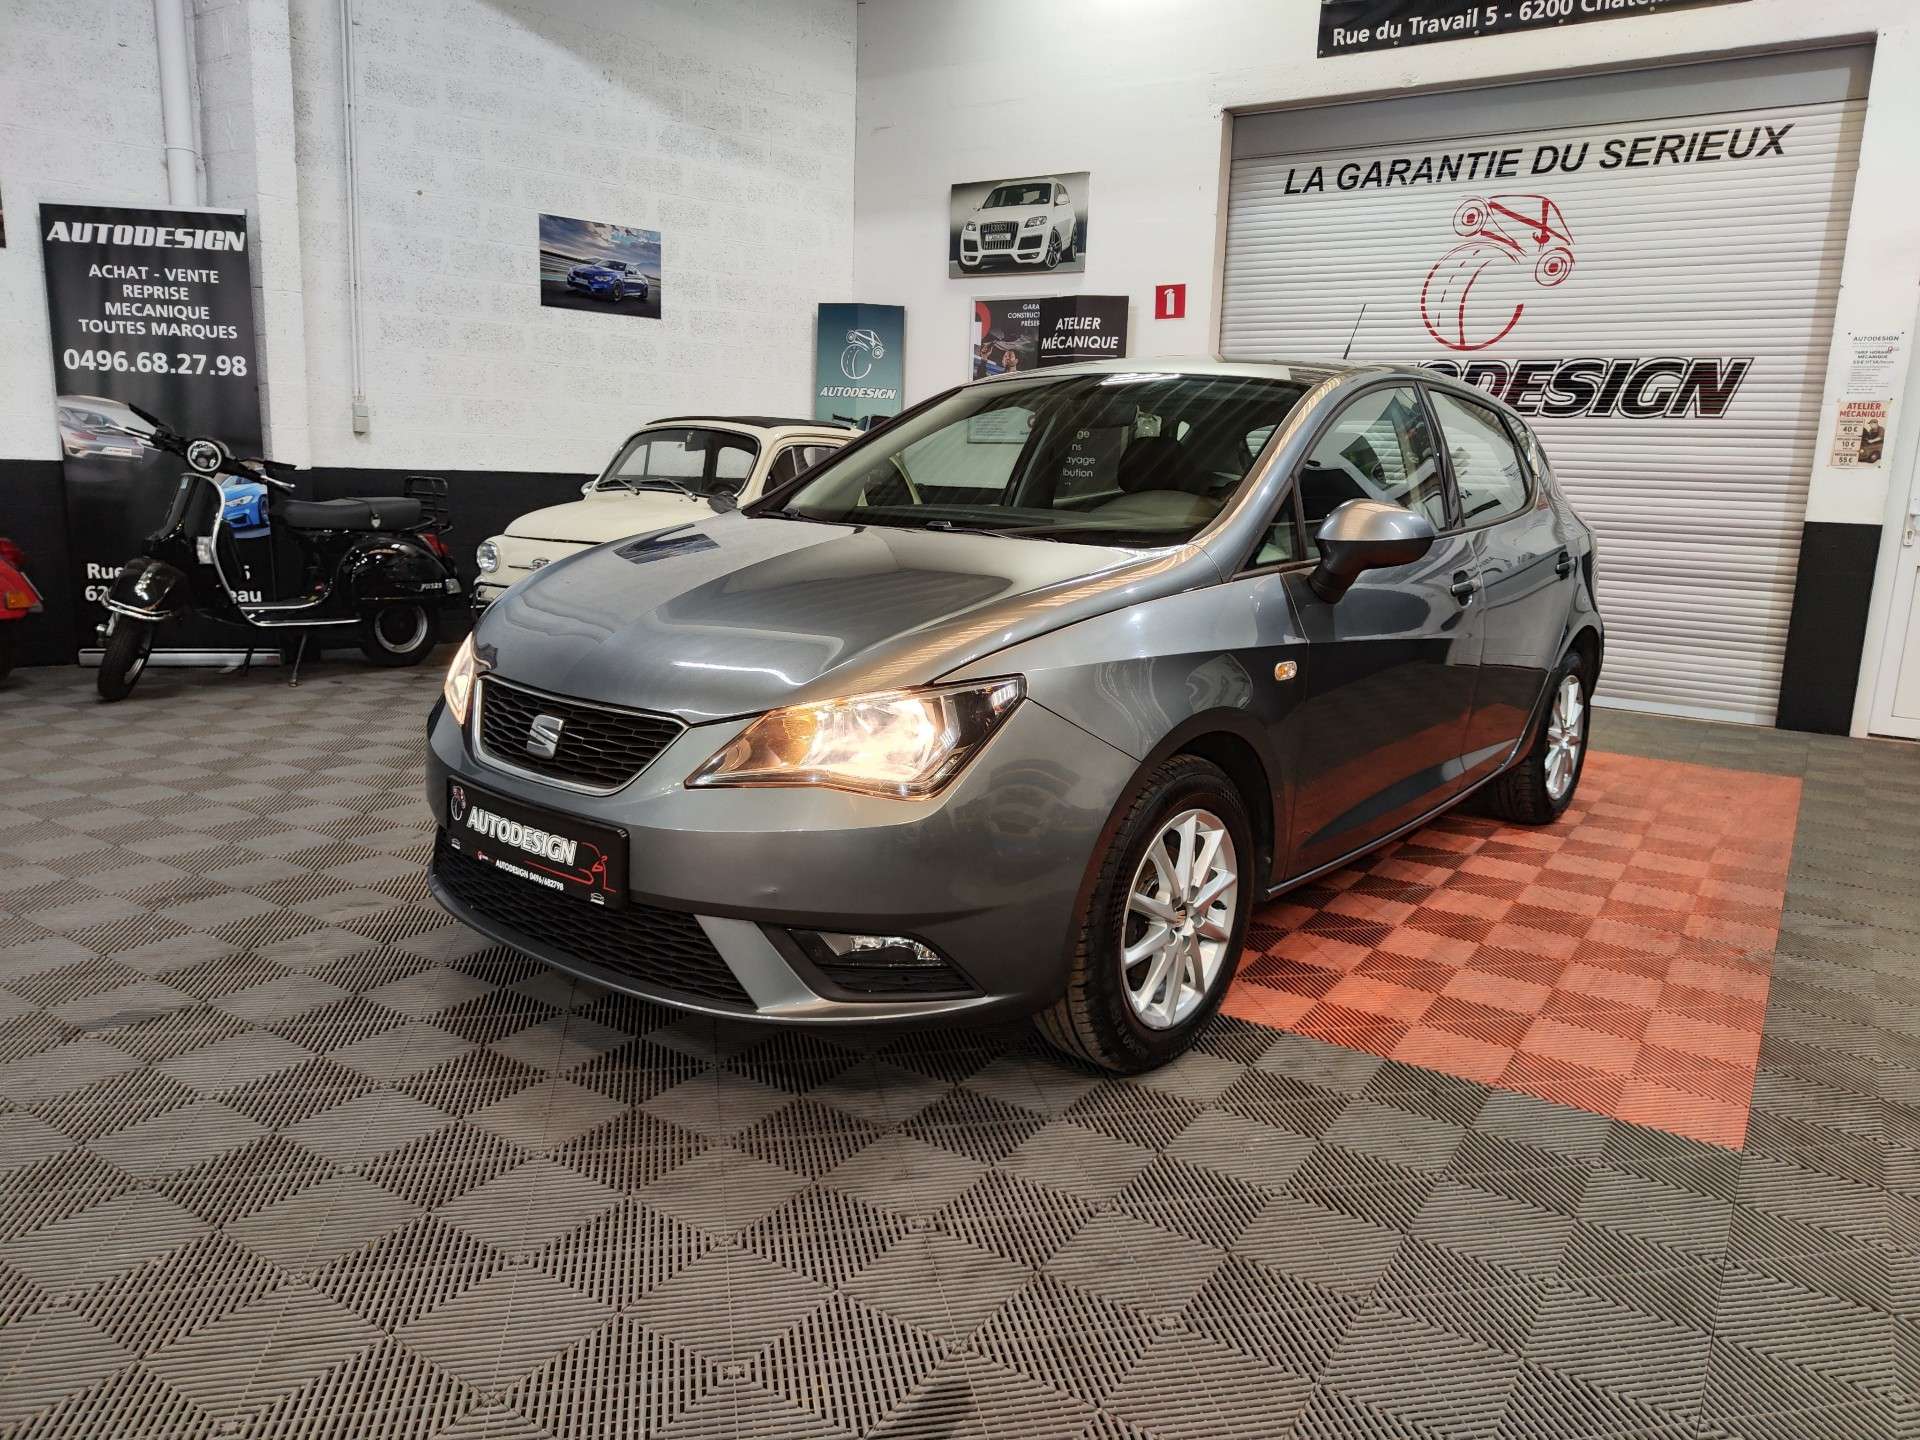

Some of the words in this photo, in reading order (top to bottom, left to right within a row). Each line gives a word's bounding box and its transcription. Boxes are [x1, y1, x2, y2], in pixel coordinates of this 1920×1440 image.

[1333, 27, 1370, 46] Rue
[1375, 19, 1402, 40] du
[1409, 7, 1479, 36] Travail
[1485, 6, 1498, 26] 5
[1519, 0, 1573, 20] 6200
[1284, 166, 1324, 194] LA
[1336, 149, 1523, 190] GARANTIE
[1530, 142, 1590, 175] DU
[1599, 123, 1796, 170] SERIEUX
[47, 221, 245, 252] AUTODESIGN
[89, 264, 149, 280] ACHAT
[164, 268, 220, 284] VENTE
[122, 284, 190, 300] REPRISE
[104, 302, 210, 320] MECANIQUE
[78, 319, 146, 335] TOUTES
[151, 322, 238, 340] MARQUES
[1056, 317, 1101, 331] ATELIER
[1041, 333, 1119, 350] MÉCANIQUE
[63, 349, 248, 377] 0496.68.27.98
[820, 386, 897, 400] AUTODESIGN
[1847, 402, 1881, 410] ATELIER
[466, 805, 578, 866] AUTODESIGN
[495, 860, 529, 879] AUTODESIGN
